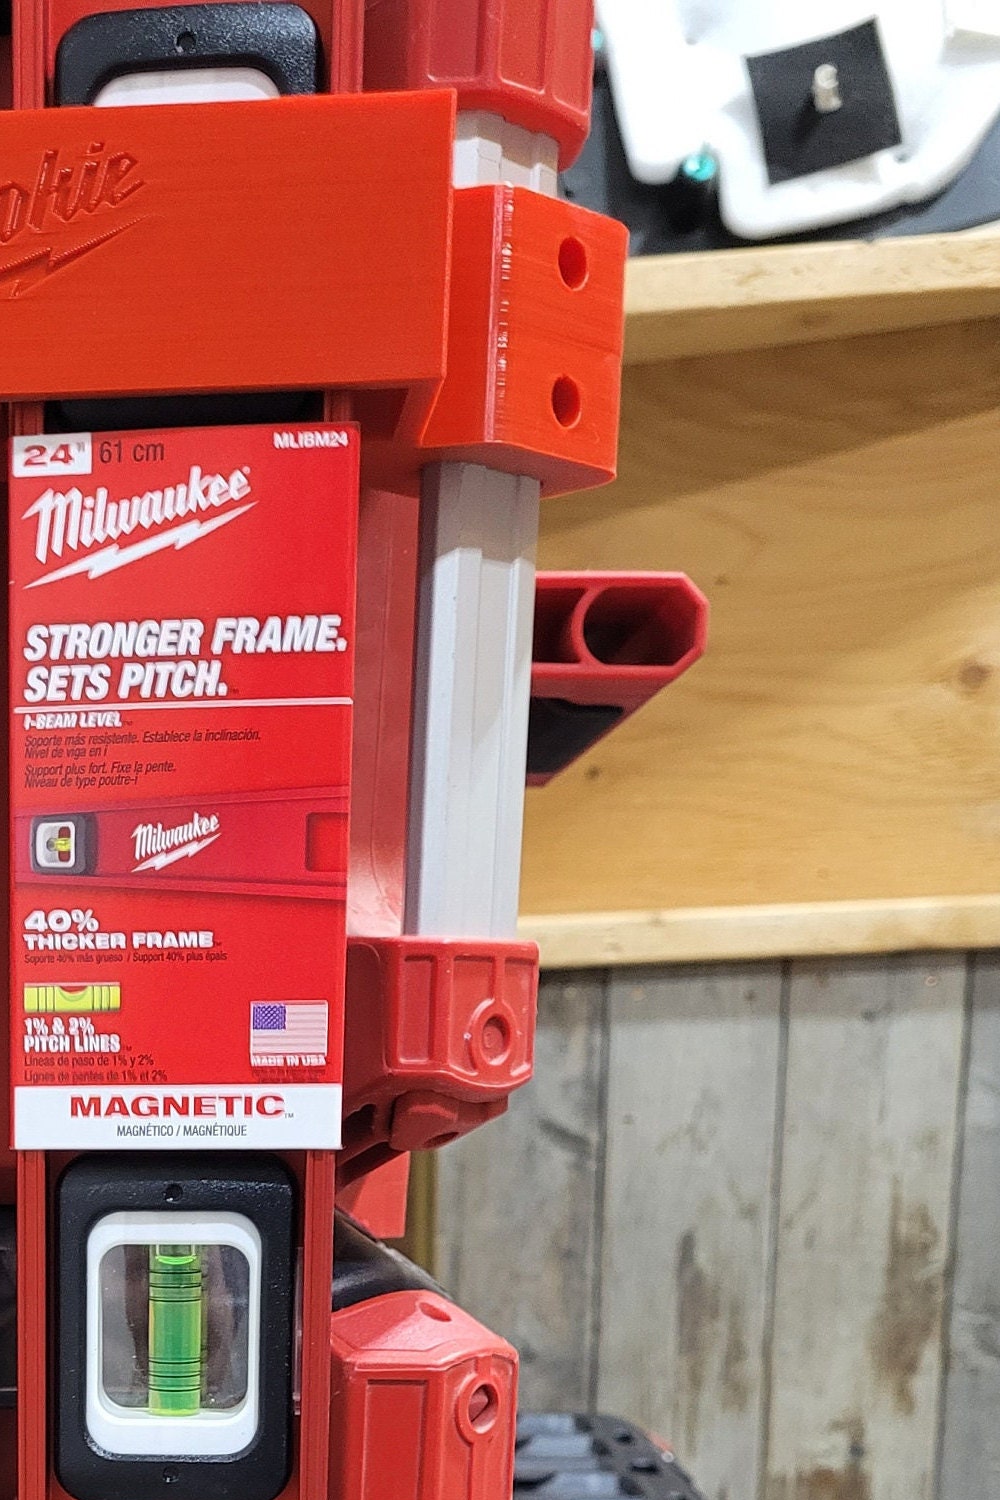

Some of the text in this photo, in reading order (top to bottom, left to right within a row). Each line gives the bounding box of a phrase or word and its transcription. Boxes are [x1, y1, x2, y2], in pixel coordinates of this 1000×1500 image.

[273, 431, 348, 449] MLIBM24
[100, 441, 122, 464] 61
[133, 442, 165, 462] cm
[21, 465, 252, 564] Milwaukee
[23, 614, 348, 661] STRONGER FRAME.
[23, 660, 228, 702] SETS PITCH.
[24, 711, 122, 730] I-BEAM LEVEL
[130, 812, 221, 860] Milwaukee
[23, 909, 99, 932] 40%
[23, 931, 215, 950] THICKER FRAME
[24, 1017, 49, 1035] 1%
[23, 1033, 120, 1053] PITCH LINES
[286, 1055, 300, 1066] IN
[301, 1055, 327, 1066] USA
[70, 1095, 285, 1118] MAGNETIC
[116, 1123, 173, 1137] MAGNÉTICO
[183, 1122, 248, 1138] MAGNÉTIQUE
